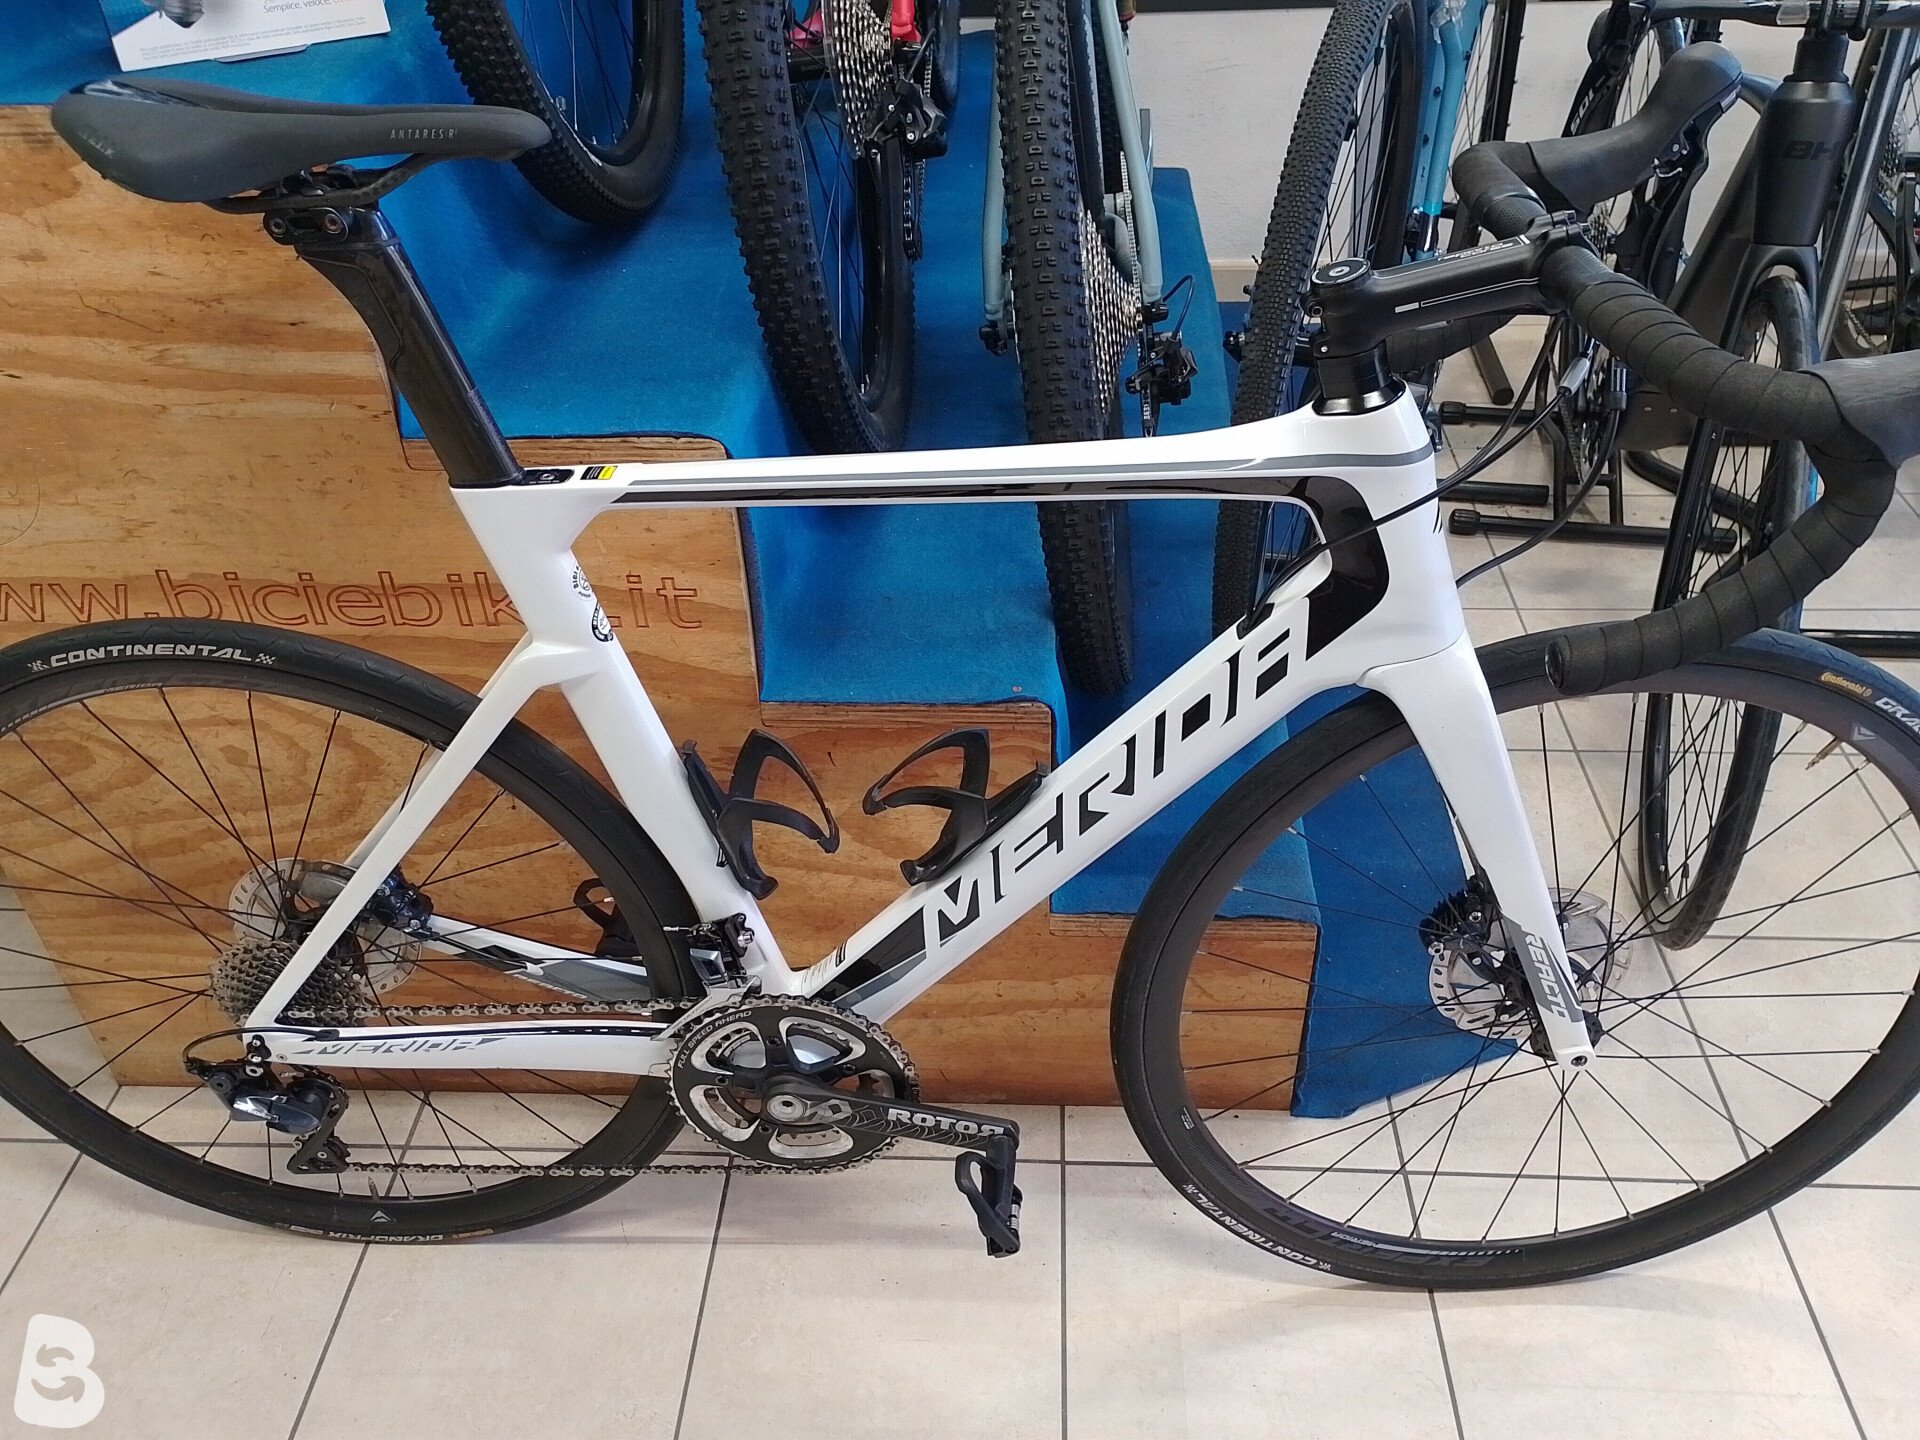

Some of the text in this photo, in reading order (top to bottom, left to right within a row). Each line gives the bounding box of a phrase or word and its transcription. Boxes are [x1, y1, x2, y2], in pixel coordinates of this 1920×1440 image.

[390, 129, 443, 139] ANTARES
[1783, 140, 1840, 160] BH
[50, 643, 252, 668] CONTINENTAL
[924, 597, 1310, 956] MERIDA
[1525, 935, 1572, 1021] REACTO
[677, 1050, 690, 1069] FULL
[688, 1025, 713, 1048] SPEED
[715, 1010, 752, 1027] AHEAD
[1194, 1193, 1317, 1265] CONTINENTAL
